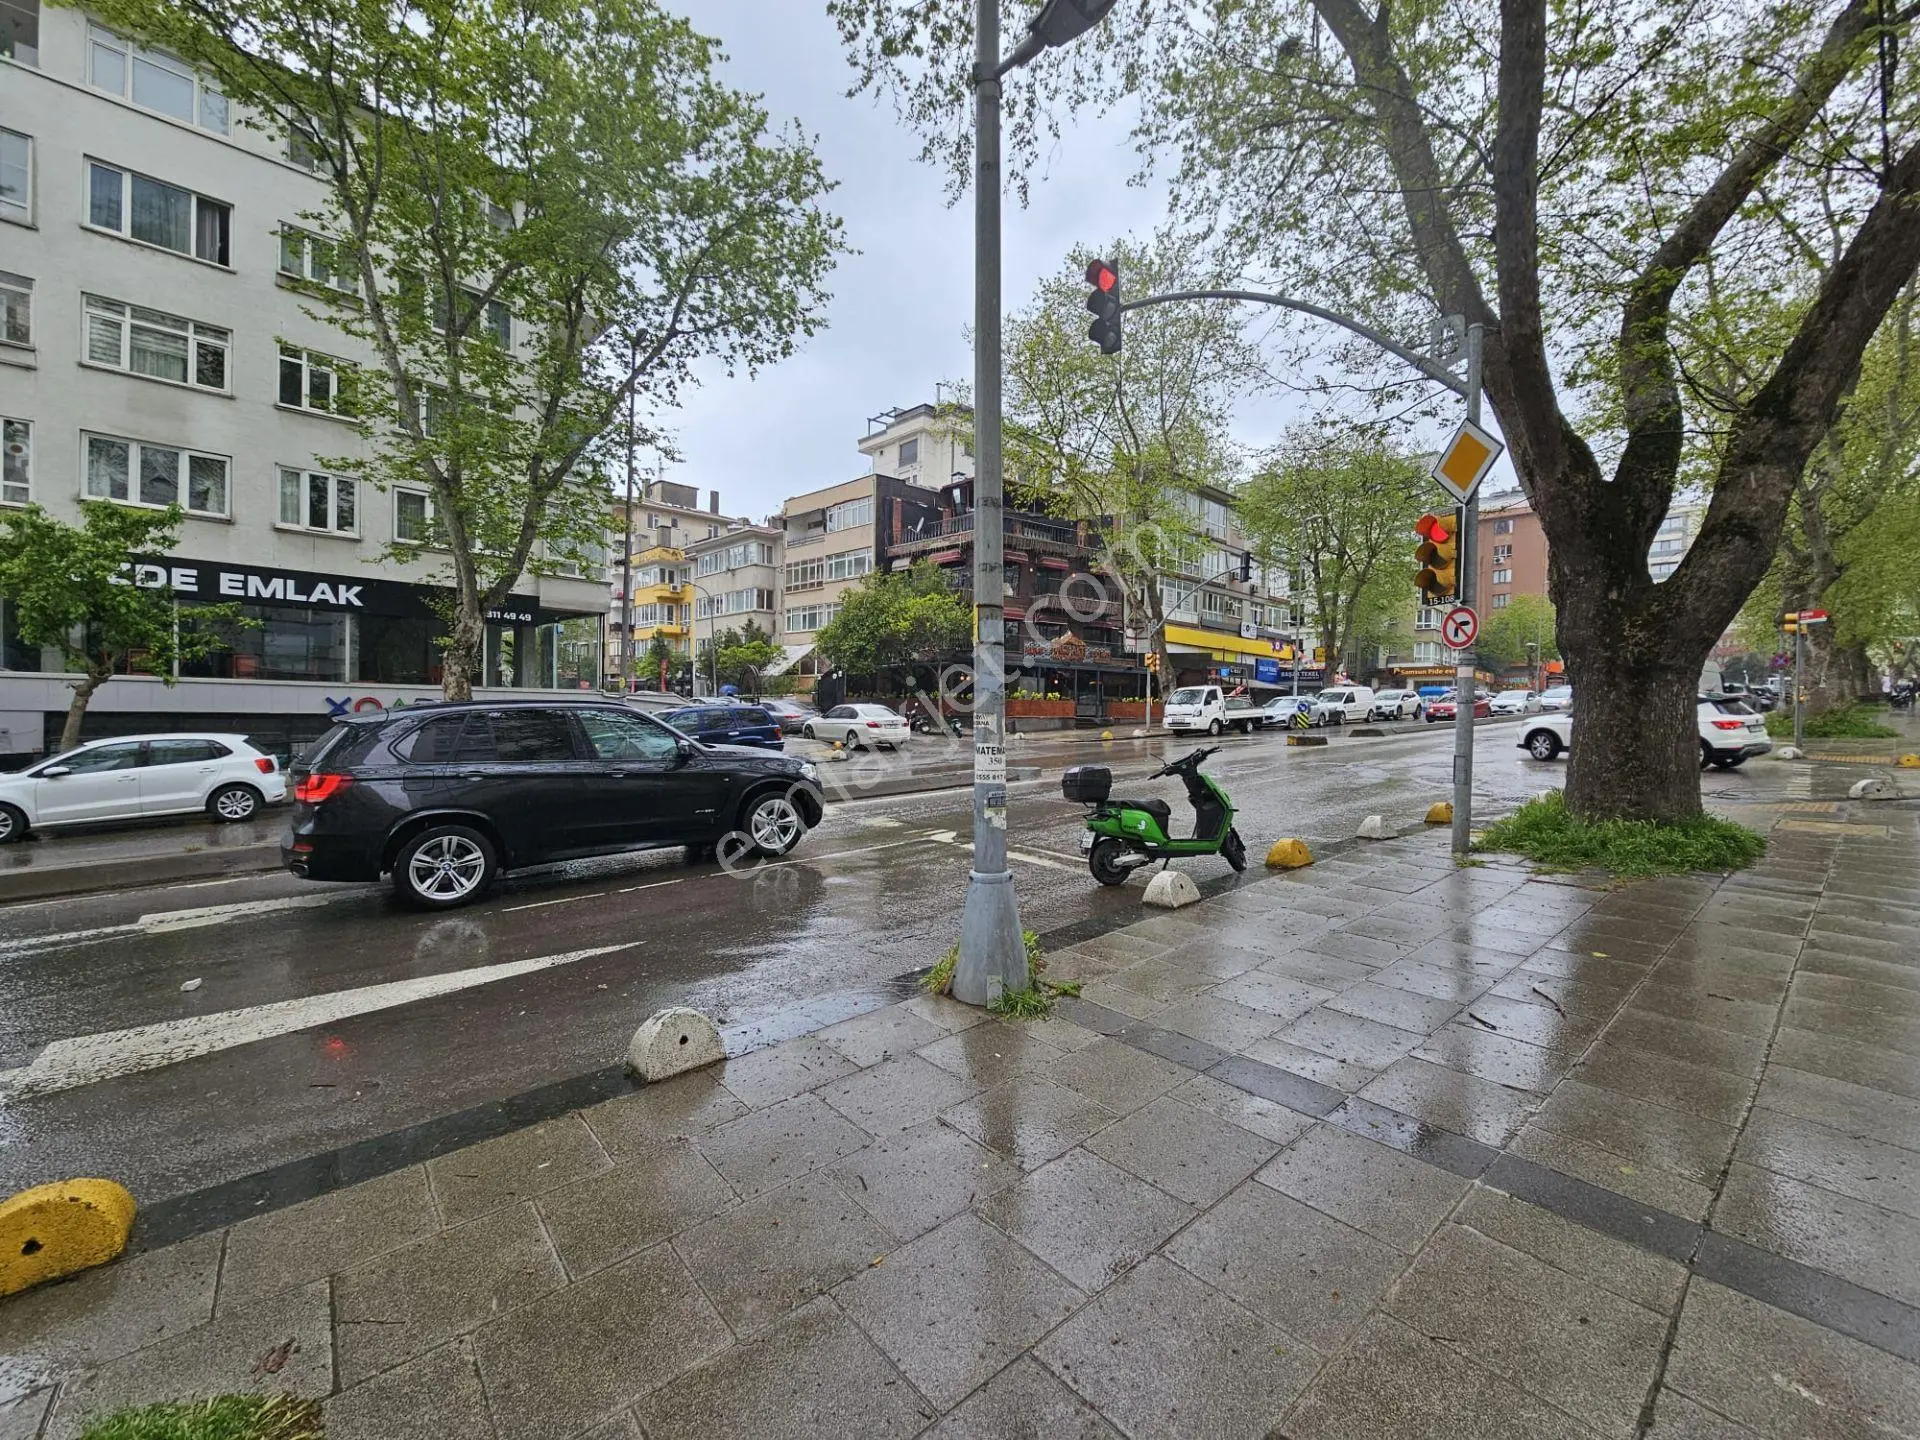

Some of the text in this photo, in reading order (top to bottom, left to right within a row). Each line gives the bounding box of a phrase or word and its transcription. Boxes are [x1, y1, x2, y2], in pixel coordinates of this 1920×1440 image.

[219, 572, 364, 607] EMLAK
[503, 611, 517, 620] 49
[518, 613, 532, 622] 49
[1400, 668, 1427, 676] Samsun
